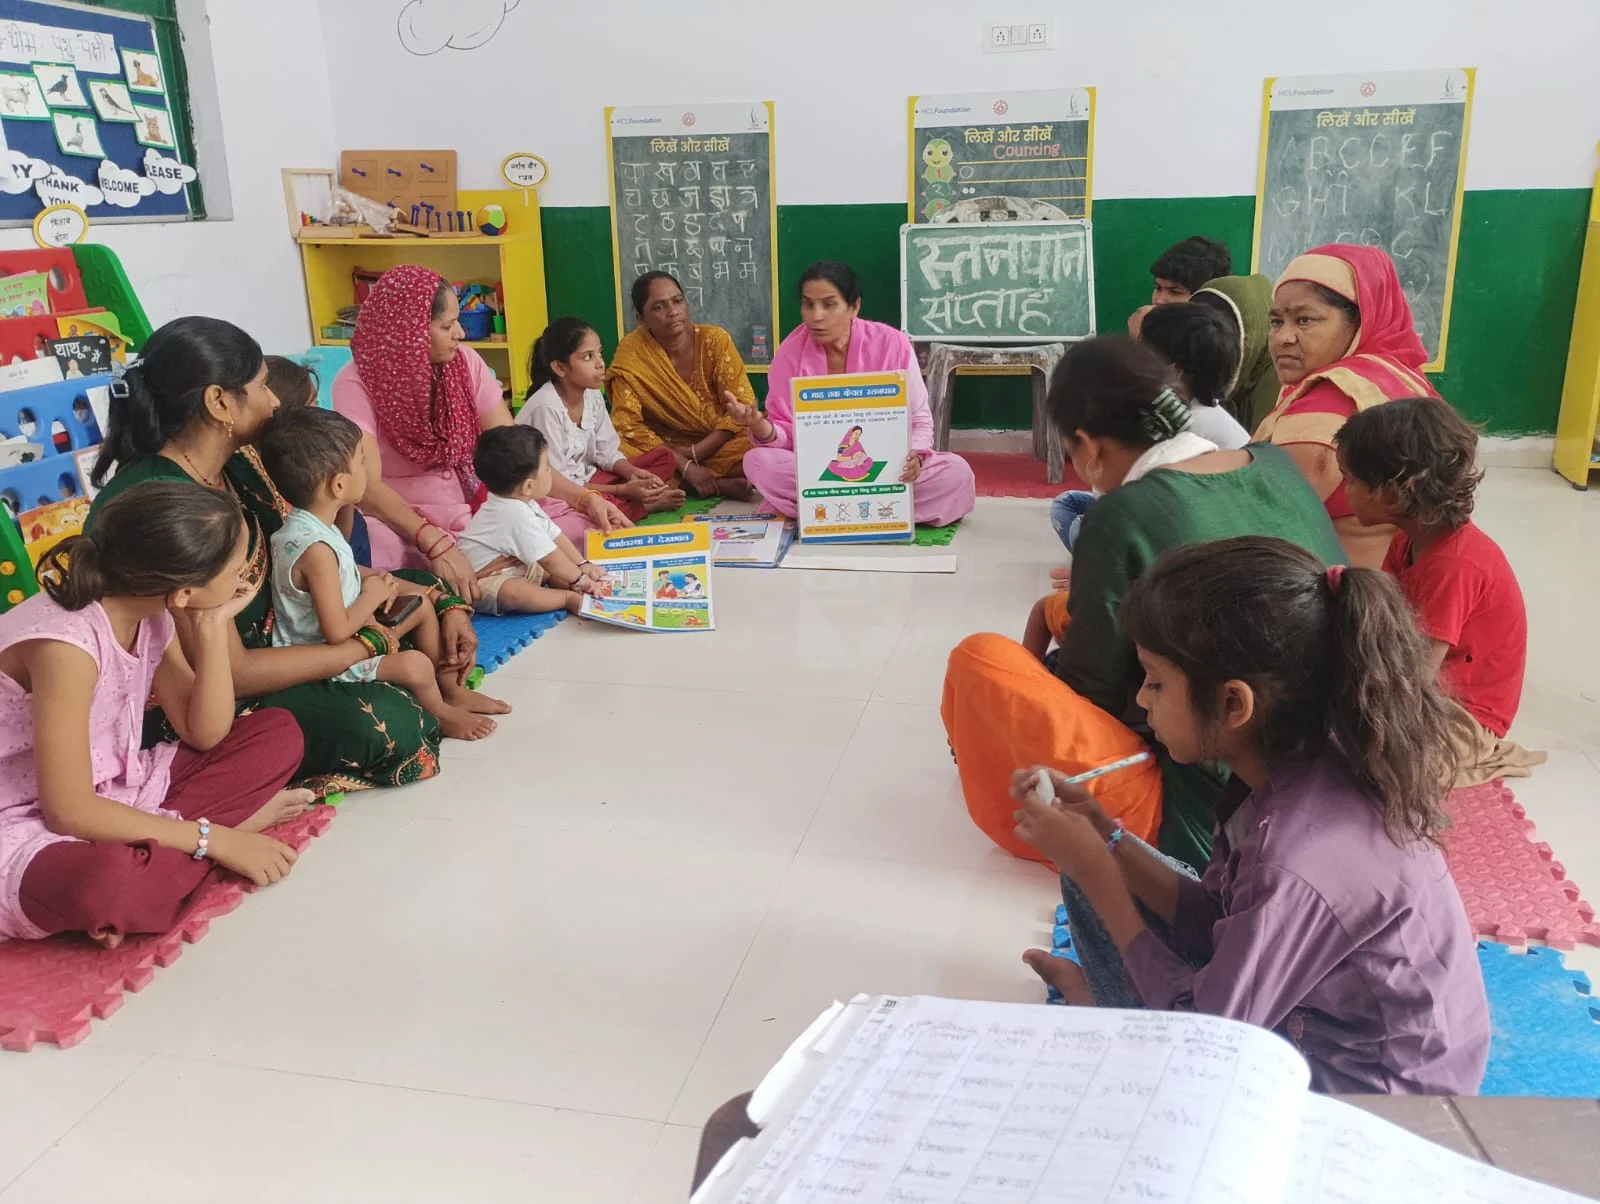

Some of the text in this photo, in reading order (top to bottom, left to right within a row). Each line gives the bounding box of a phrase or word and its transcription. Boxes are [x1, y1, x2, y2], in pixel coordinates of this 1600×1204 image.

[50, 33, 76, 63] पशु
[1316, 111, 1350, 129] लिखें
[1383, 108, 1417, 126] सीखें
[650, 138, 678, 153] लिखें
[703, 137, 730, 152] सीखें
[964, 127, 994, 144] लिखें
[1023, 125, 1053, 142] सीखें
[993, 143, 1061, 160] Counting
[912, 231, 1086, 290] स्तनपान
[919, 287, 1055, 334] सप्ताह
